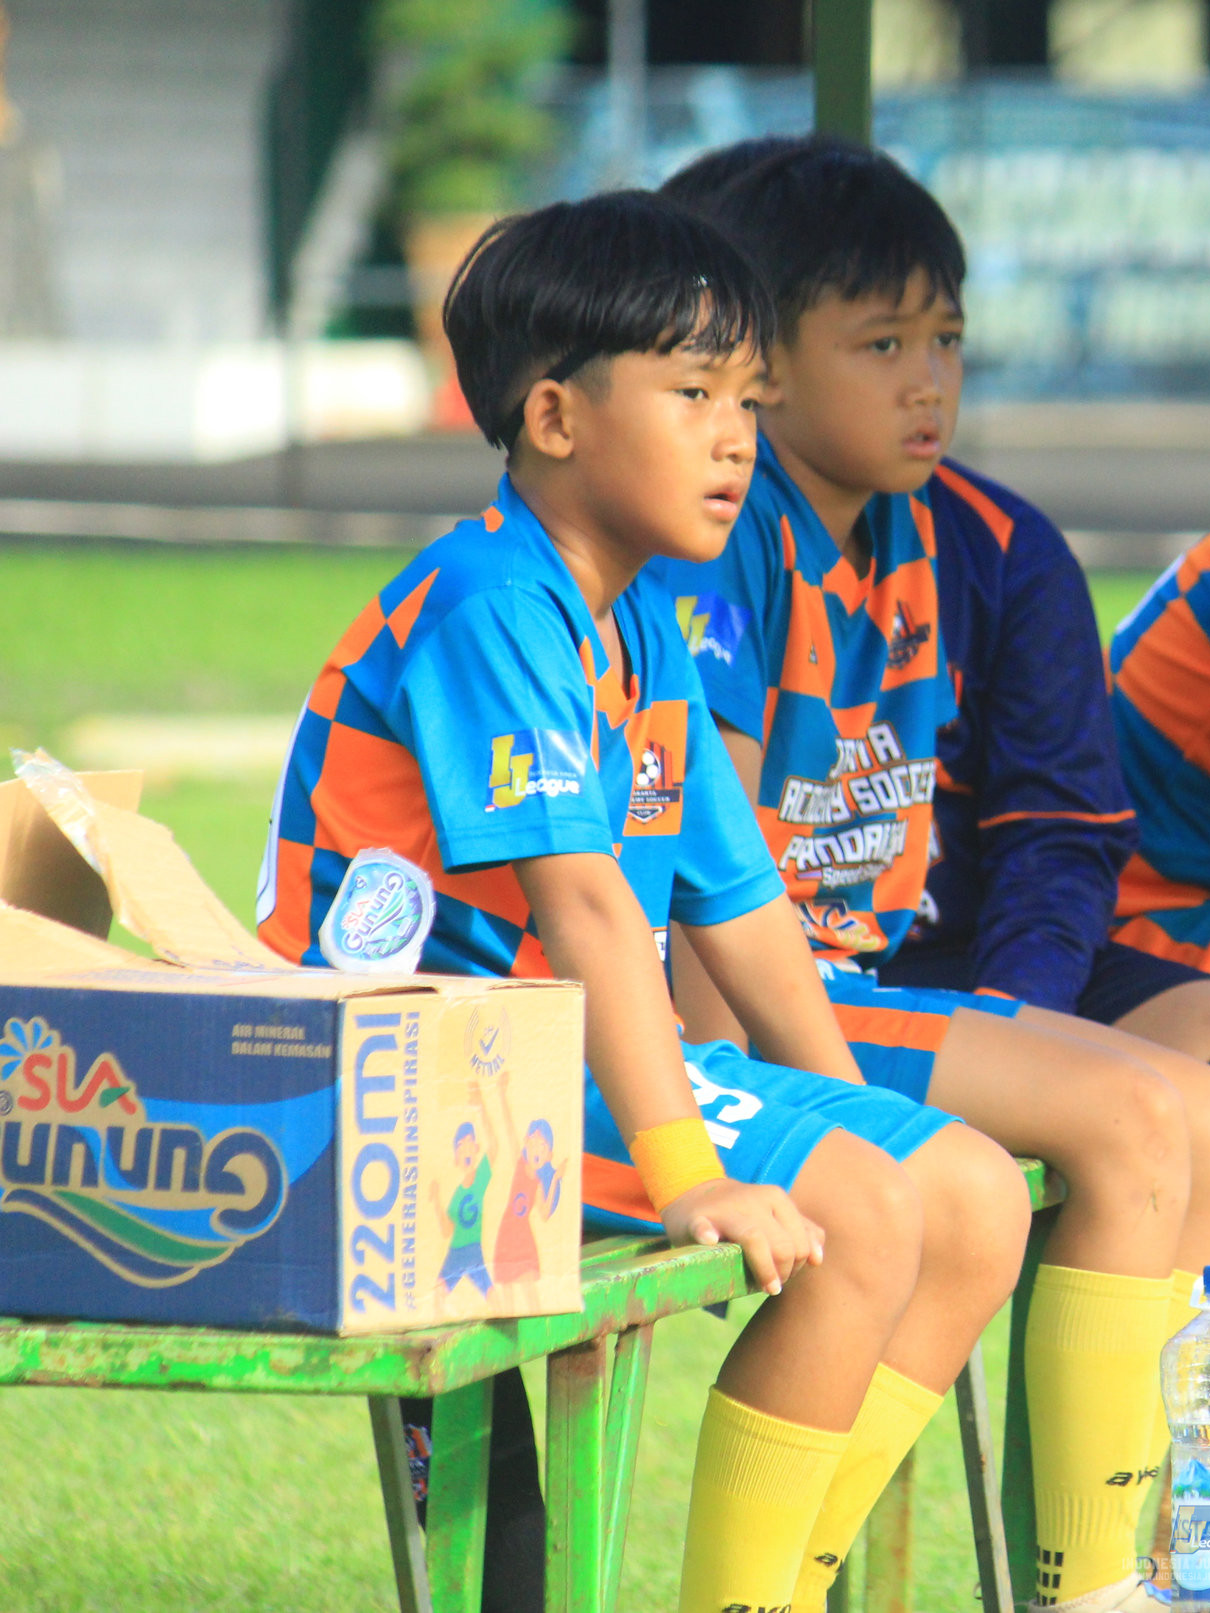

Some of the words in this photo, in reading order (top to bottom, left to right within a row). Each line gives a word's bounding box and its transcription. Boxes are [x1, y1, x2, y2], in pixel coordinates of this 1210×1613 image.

[514, 777, 580, 797] League
[254, 1025, 306, 1040] MINERAL
[231, 1041, 272, 1056] DALAM
[274, 1043, 333, 1059] KEMASAN
